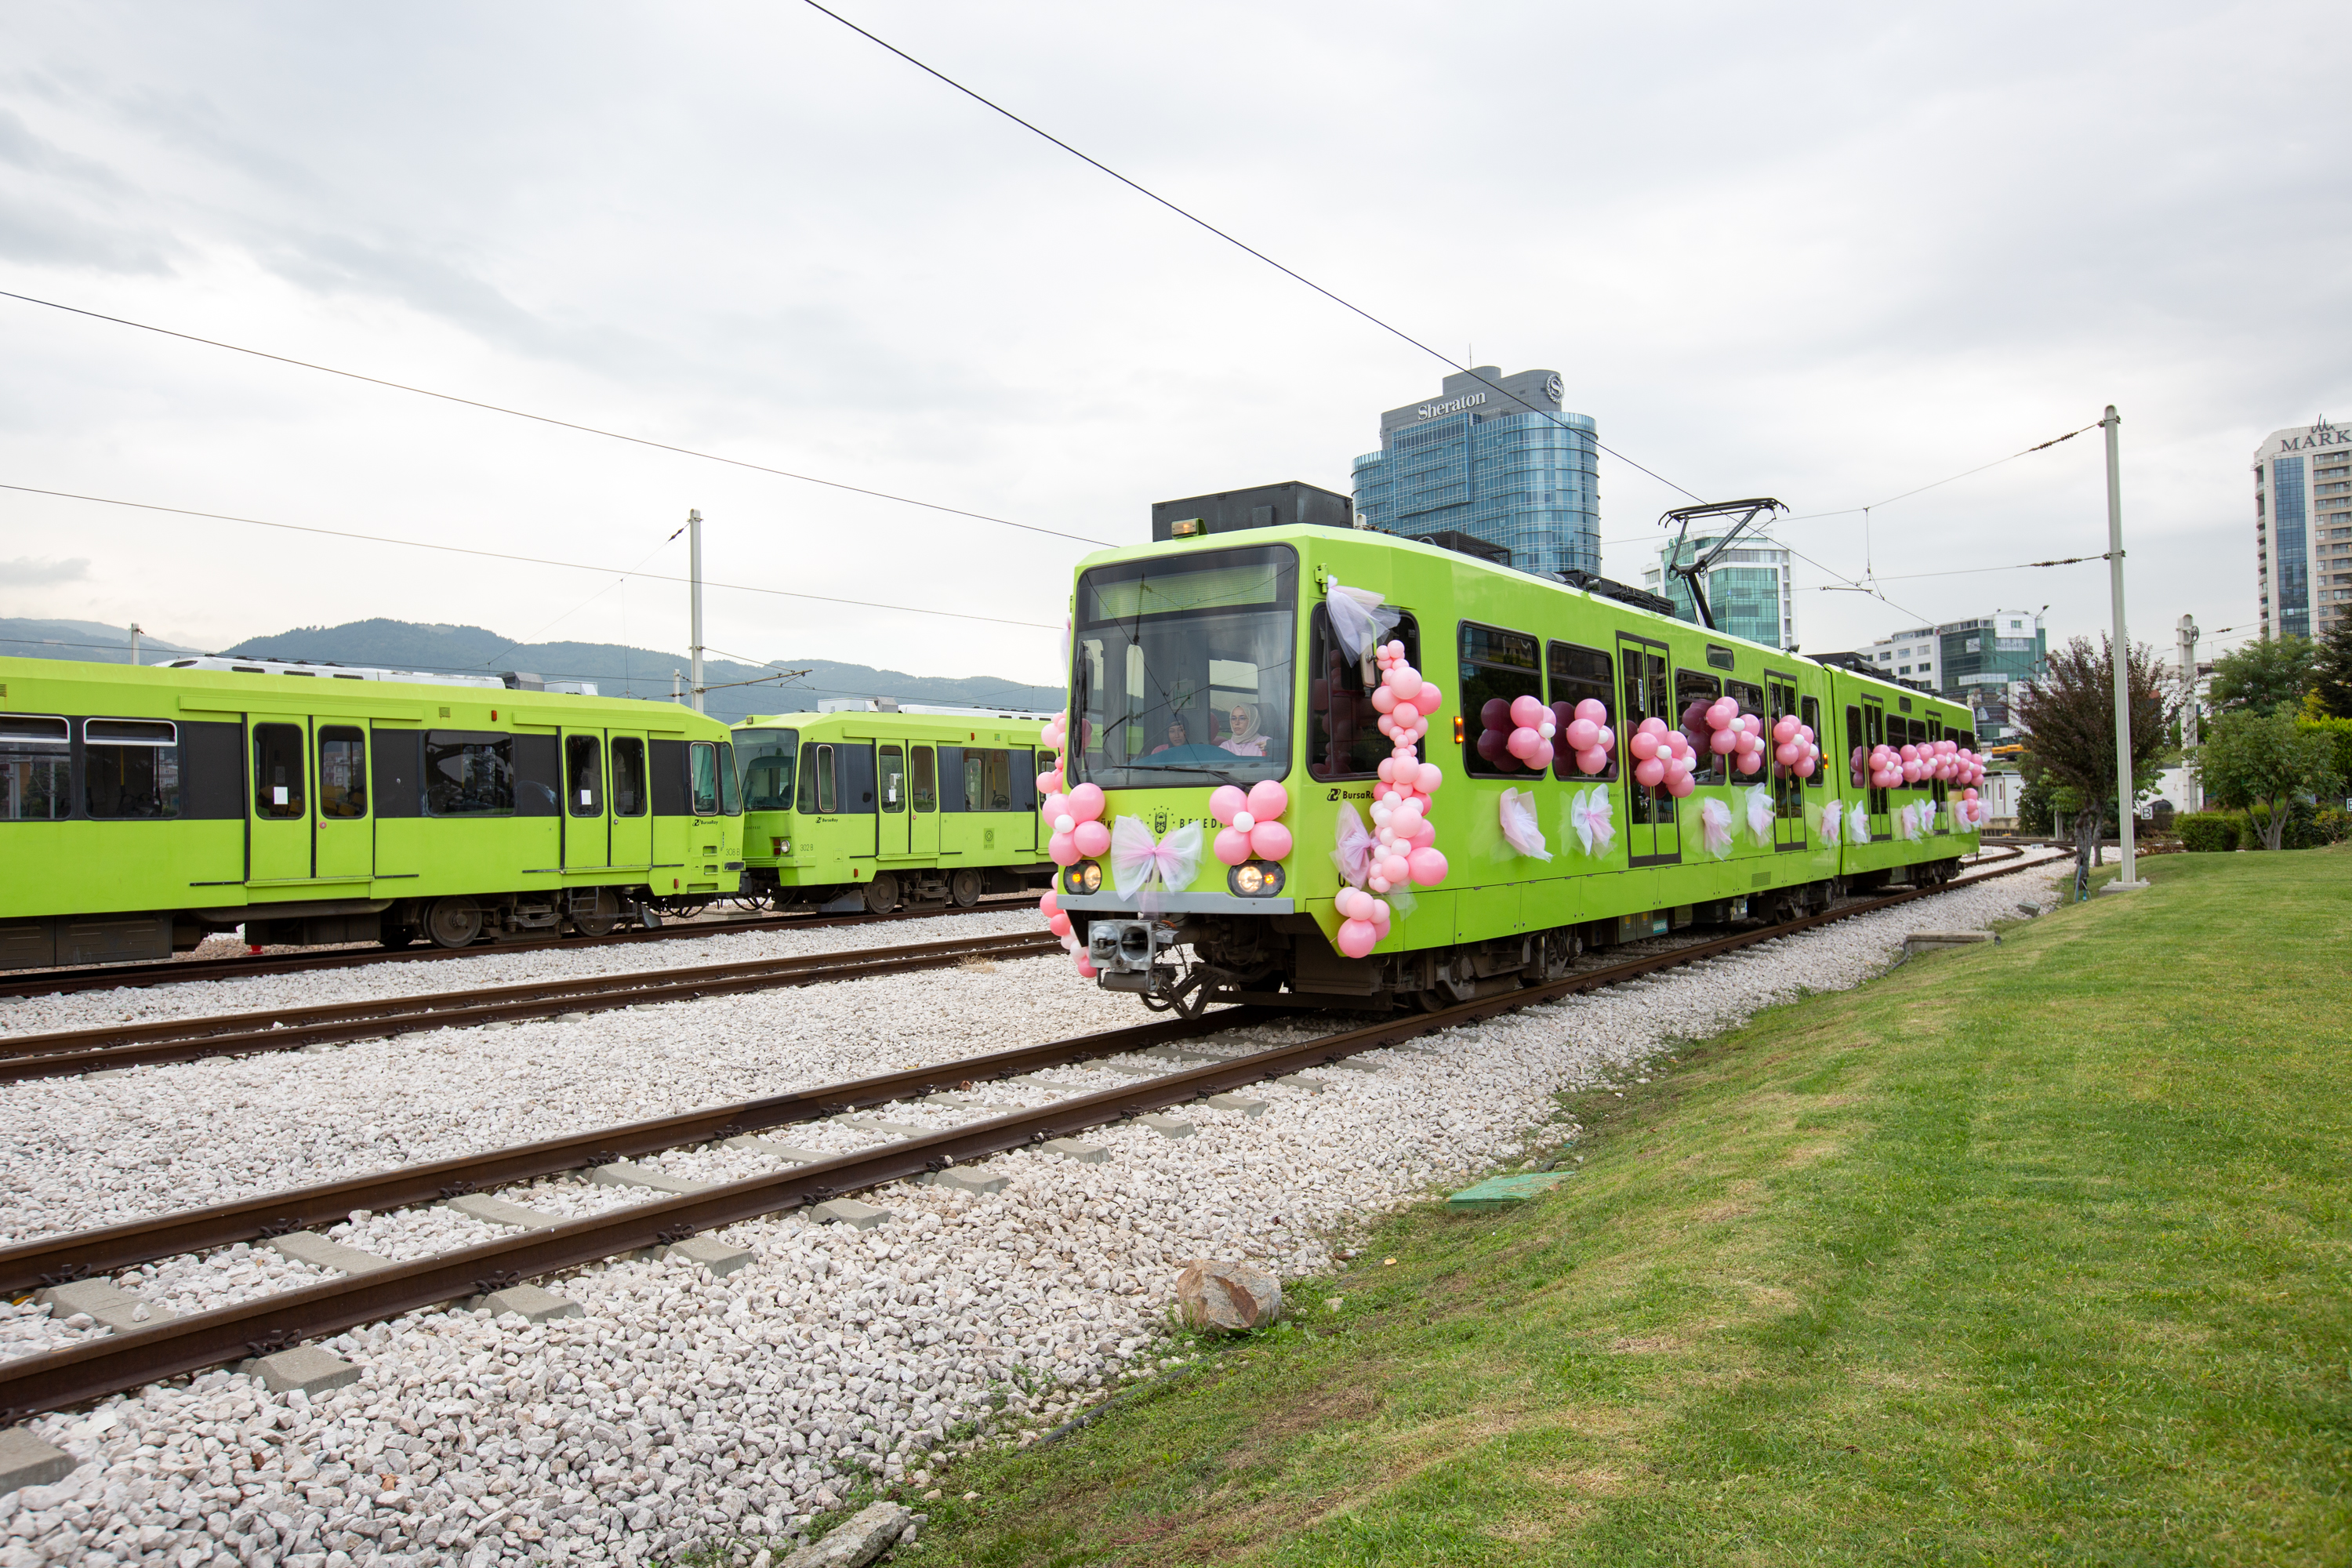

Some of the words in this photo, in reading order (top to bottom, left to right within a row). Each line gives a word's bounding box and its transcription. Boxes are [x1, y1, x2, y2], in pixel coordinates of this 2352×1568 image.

[1418, 392, 1486, 421] Sheraton
[1343, 790, 1374, 799] BursaRa
[2143, 808, 2151, 818] B
[725, 848, 735, 856] 308
